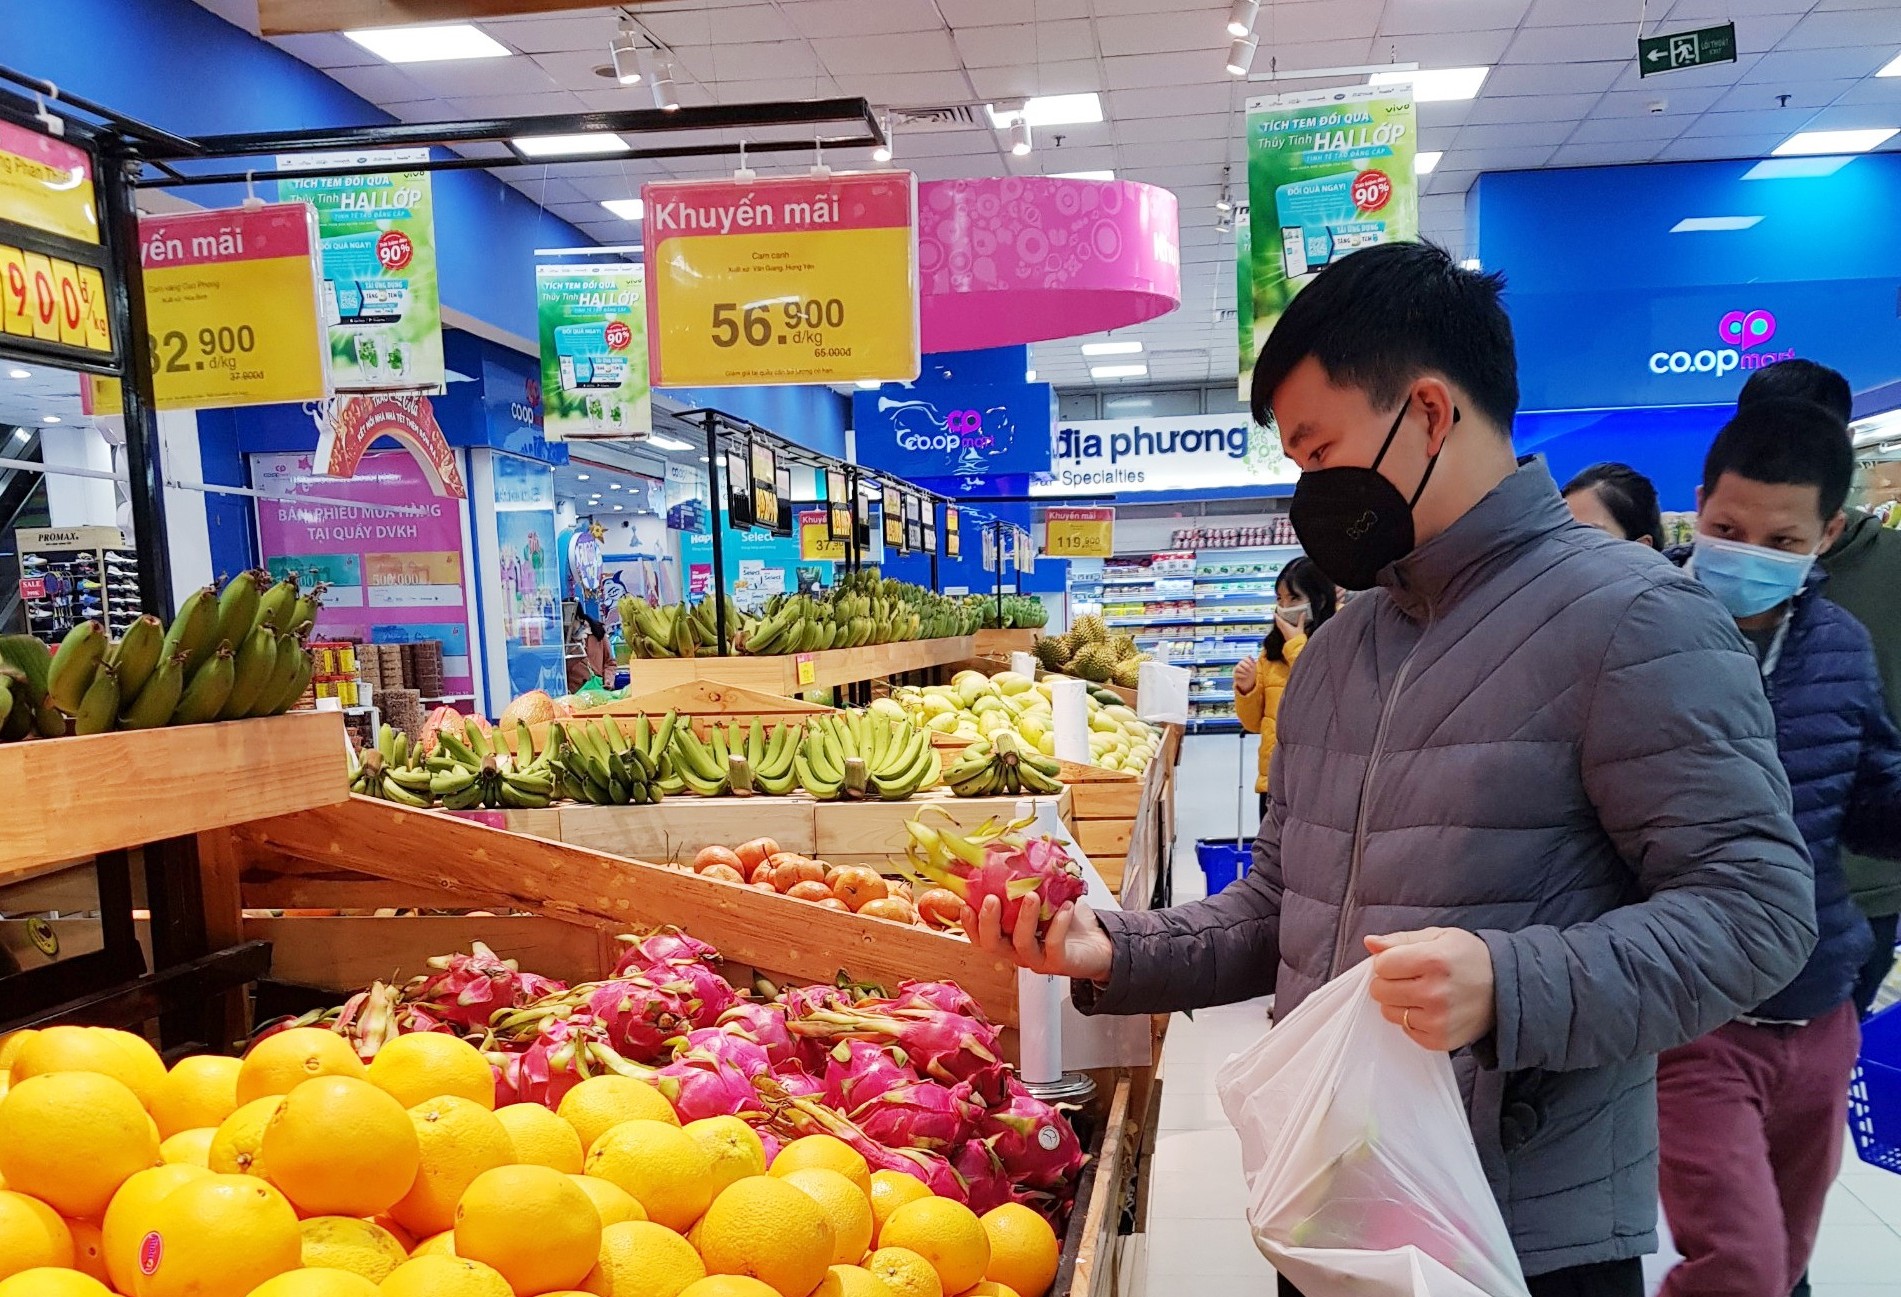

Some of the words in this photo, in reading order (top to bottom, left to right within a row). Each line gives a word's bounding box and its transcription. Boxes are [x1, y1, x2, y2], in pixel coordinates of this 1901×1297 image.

[1385, 103, 1410, 113] vivo
[1262, 119, 1289, 132] TÍCH
[1291, 117, 1316, 128] TEM
[1313, 129, 1355, 151] HAI
[1359, 122, 1406, 146] LỚP
[294, 178, 318, 189] TÍCH
[321, 177, 342, 187] TEM
[340, 191, 377, 211] HAI
[380, 187, 422, 209] LỚP
[1355, 182, 1390, 206] 90%
[655, 192, 773, 234] Khuyến
[784, 194, 839, 224] mãi
[192, 226, 244, 257] mãi
[380, 243, 411, 264] 90%
[8, 261, 80, 330] 900
[545, 281, 563, 290] TÍCH
[564, 281, 582, 289] TEM
[579, 292, 606, 306] HAI
[609, 290, 640, 306] LỚP
[711, 298, 845, 348] 56.900
[607, 331, 630, 346] 90%
[792, 330, 823, 347] đ/kg
[209, 355, 237, 370] đ/kg
[1648, 349, 1739, 378] co.op
[1058, 427, 1102, 465] địa
[1111, 426, 1249, 465] phương
[1062, 469, 1145, 488] Specialties
[1049, 511, 1080, 521] Khuyến
[307, 527, 330, 544] TẠI
[332, 522, 373, 541] QUẦY
[375, 525, 418, 539] DVKH
[741, 532, 775, 543] Select
